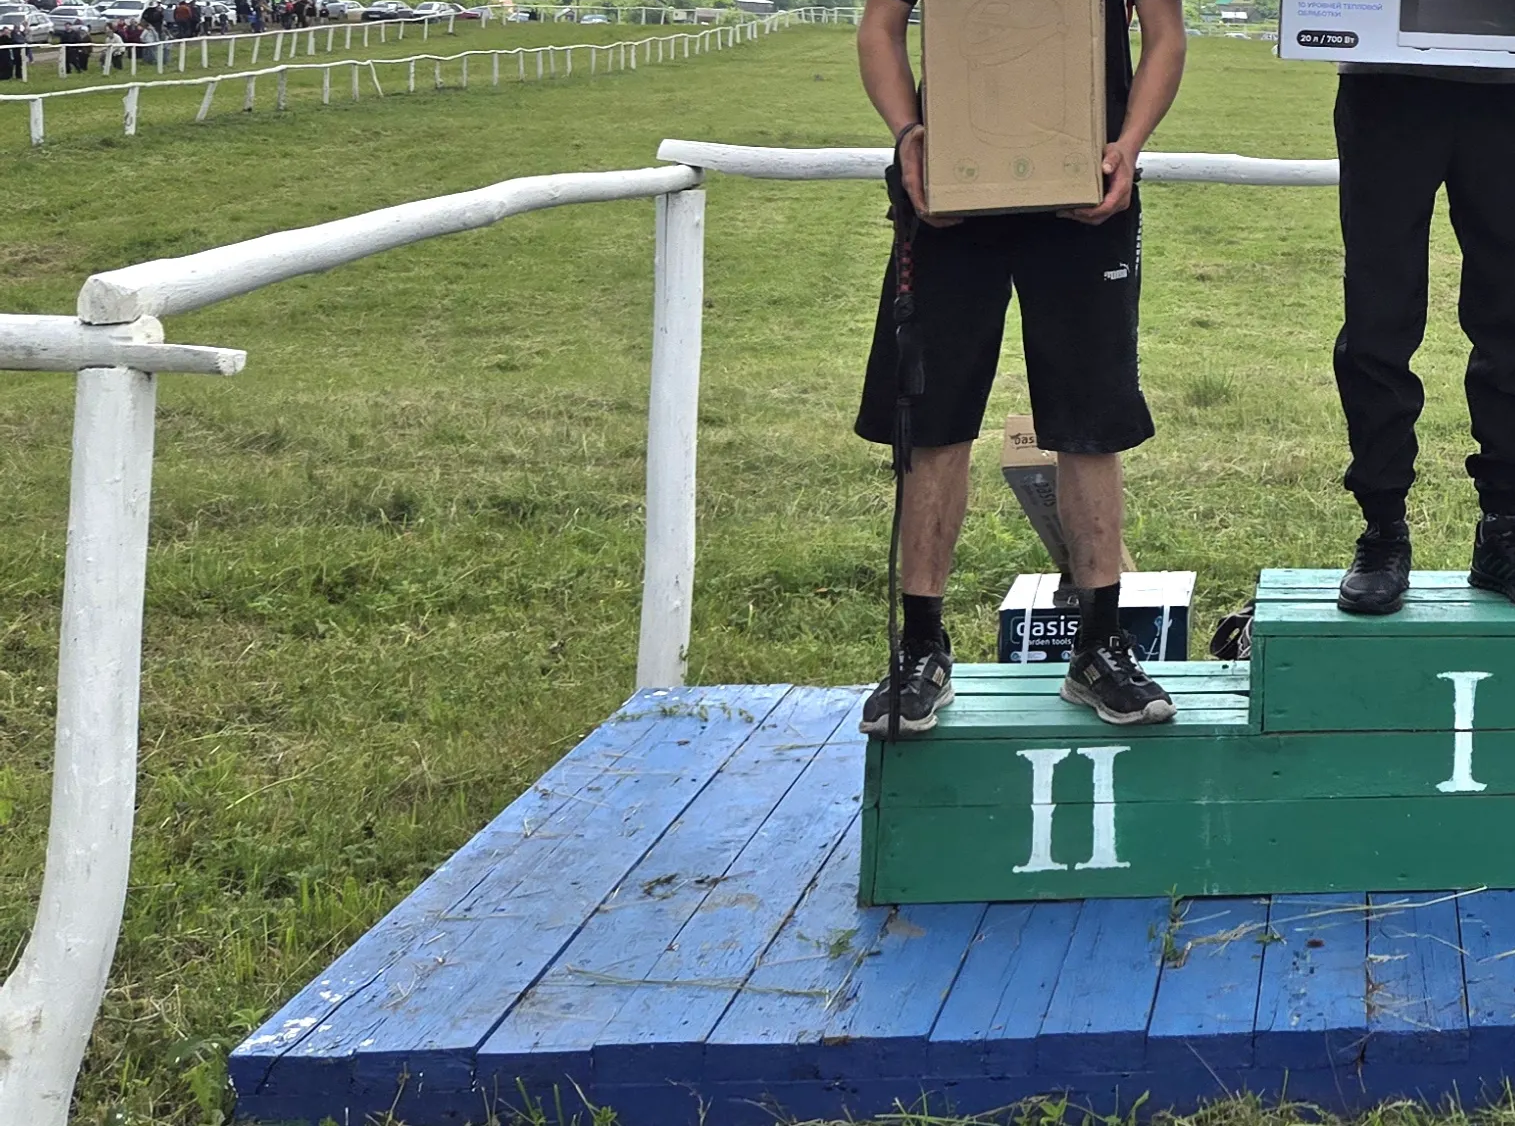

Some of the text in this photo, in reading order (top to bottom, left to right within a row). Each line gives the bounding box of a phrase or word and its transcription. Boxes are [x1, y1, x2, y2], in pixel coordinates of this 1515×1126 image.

[1300, 34, 1312, 42] 20
[1327, 35, 1343, 43] 700
[1027, 638, 1051, 646] arden
[1435, 671, 1494, 793] I
[1012, 745, 1131, 873] II
